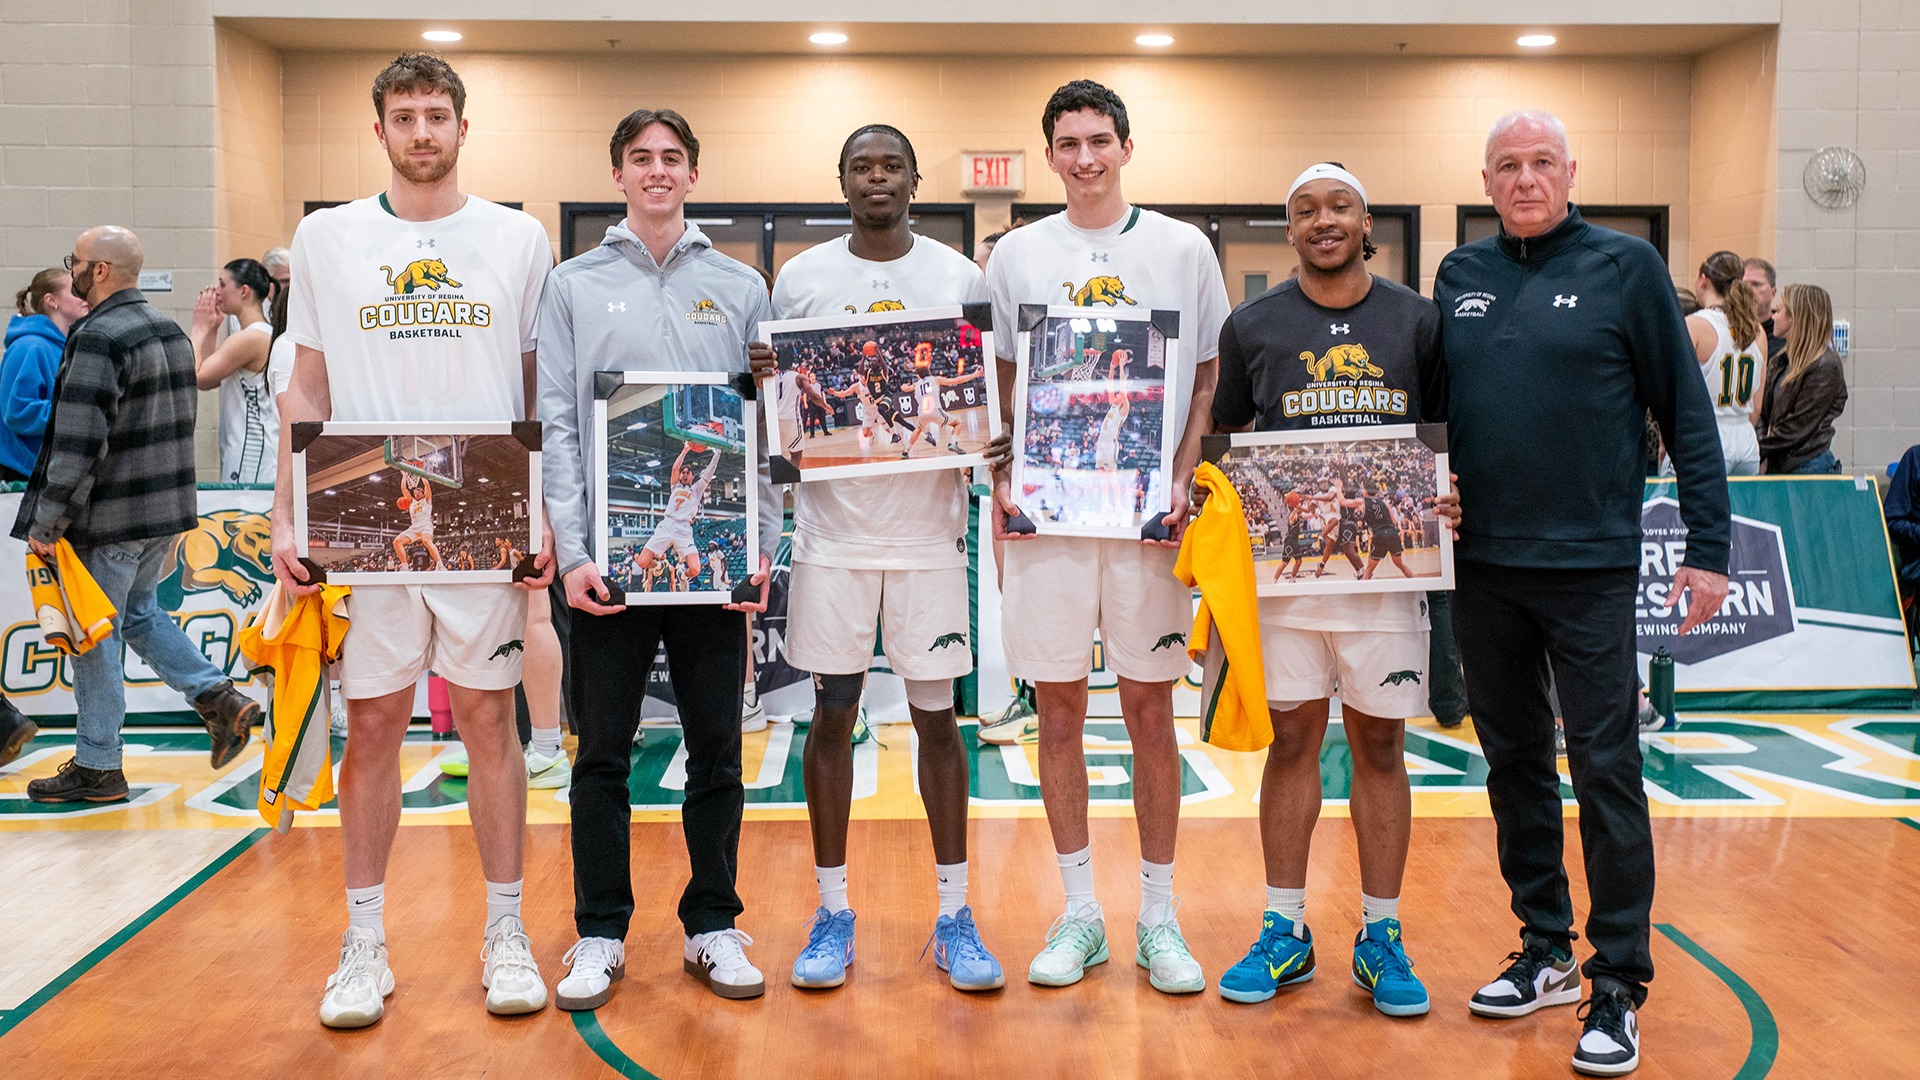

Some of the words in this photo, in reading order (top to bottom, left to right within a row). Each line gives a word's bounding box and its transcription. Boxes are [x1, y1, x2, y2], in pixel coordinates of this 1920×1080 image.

[973, 157, 1011, 186] EXIT
[384, 294, 426, 302] UNIVERSITY
[359, 301, 491, 330] COUGARS
[684, 312, 727, 323] COUGARS
[389, 328, 462, 340] BASKETBALL
[1306, 380, 1348, 389] UNIVERSITY
[1359, 380, 1385, 388] REGINA
[1717, 353, 1755, 407] 10
[1282, 386, 1408, 418] COUGARS
[1311, 414, 1382, 426] BASKETBALL
[675, 498, 685, 511] 7
